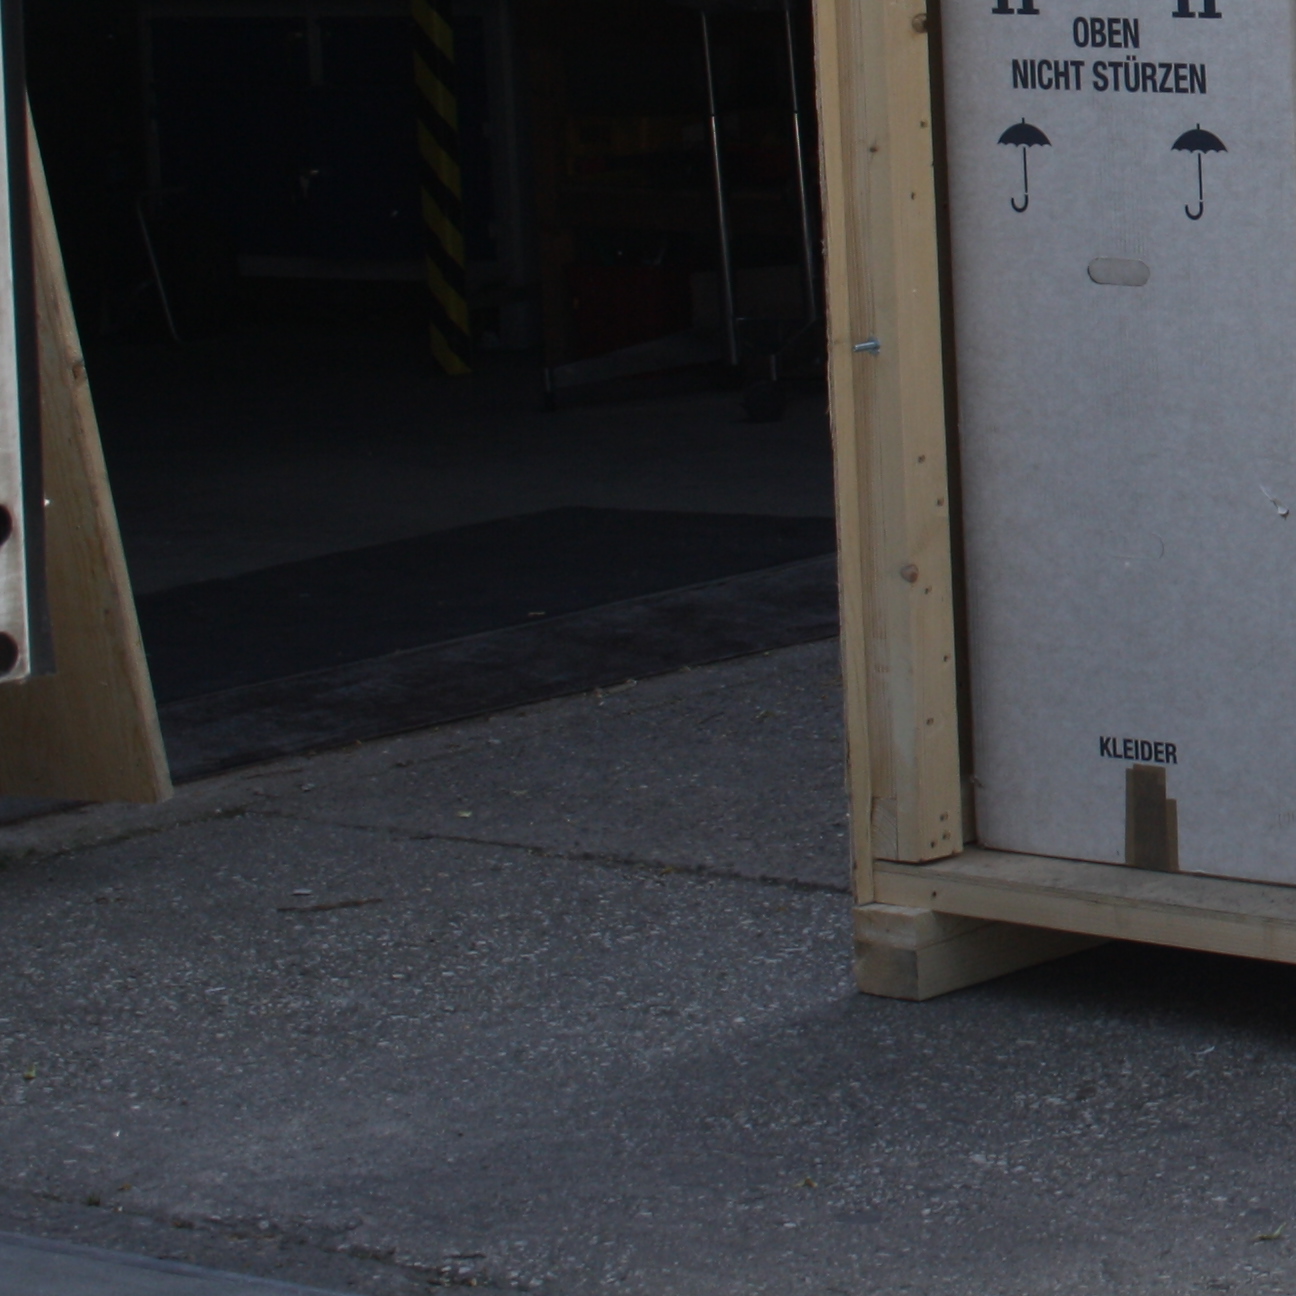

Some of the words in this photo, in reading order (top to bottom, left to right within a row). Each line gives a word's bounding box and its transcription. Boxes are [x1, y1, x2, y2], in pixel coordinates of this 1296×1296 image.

[1072, 16, 1140, 49] OBEN
[1011, 59, 1084, 92] NICHT
[1092, 55, 1207, 94] STÜRZEN
[1099, 735, 1178, 764] KLEIDER
